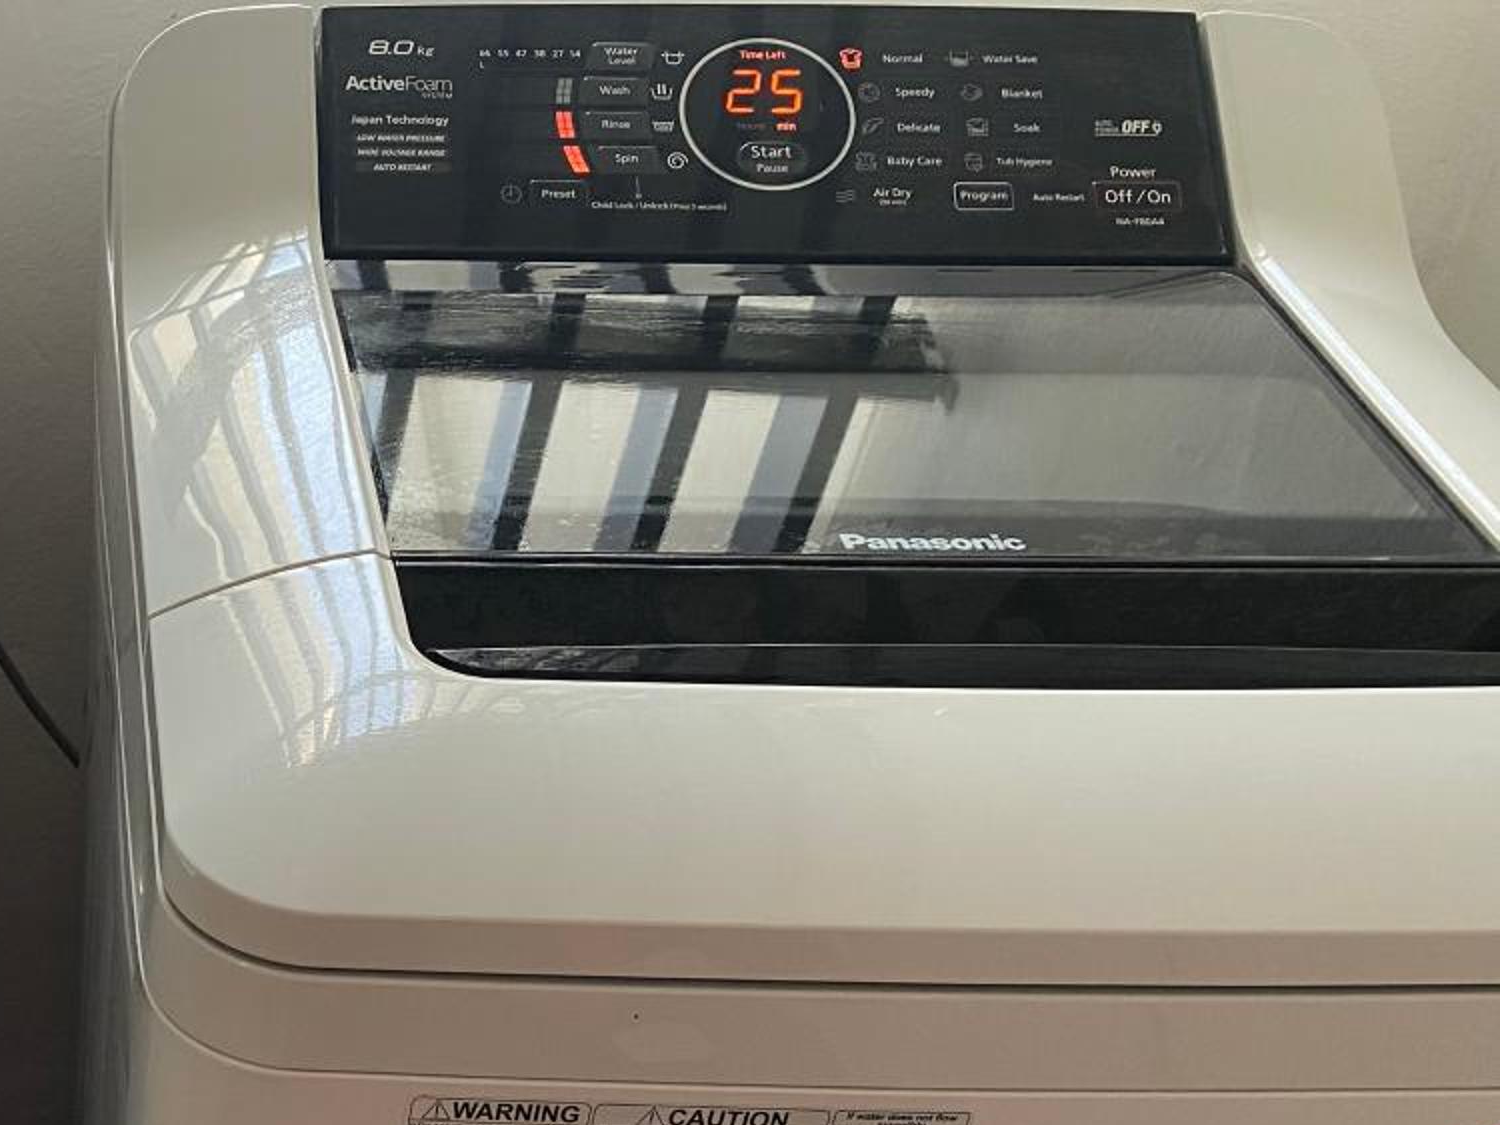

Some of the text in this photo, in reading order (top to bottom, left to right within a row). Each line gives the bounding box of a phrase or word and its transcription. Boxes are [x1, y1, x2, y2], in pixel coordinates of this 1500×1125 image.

[368, 39, 435, 59] 8.0 kg
[604, 47, 638, 56] Water
[740, 50, 787, 59] Time Left
[609, 57, 636, 65] Level
[882, 53, 924, 63] Normal
[982, 54, 1039, 63] Water Save
[345, 75, 453, 91] ActiveFoam
[599, 84, 631, 95] Wash
[726, 69, 802, 113] 25
[895, 87, 935, 100] Speedy
[1001, 88, 1043, 100] Blanket
[351, 114, 449, 127] Japan Technology
[601, 119, 631, 130] Rinse
[1121, 119, 1151, 133] OFF
[776, 123, 797, 131] min
[897, 122, 941, 133] Delicate
[1013, 122, 1041, 133] Soak
[615, 152, 639, 164] Spin
[750, 145, 792, 159] Start
[756, 163, 789, 173] Pause
[887, 156, 943, 168] Baby Care
[996, 157, 1053, 168] Tub Hygiene
[1109, 165, 1156, 178] Power
[541, 188, 576, 199] Preset
[873, 187, 912, 200] Air Dry
[960, 190, 1009, 202] Program
[838, 532, 1027, 551] Panasonic
[453, 1101, 580, 1123] WARNING
